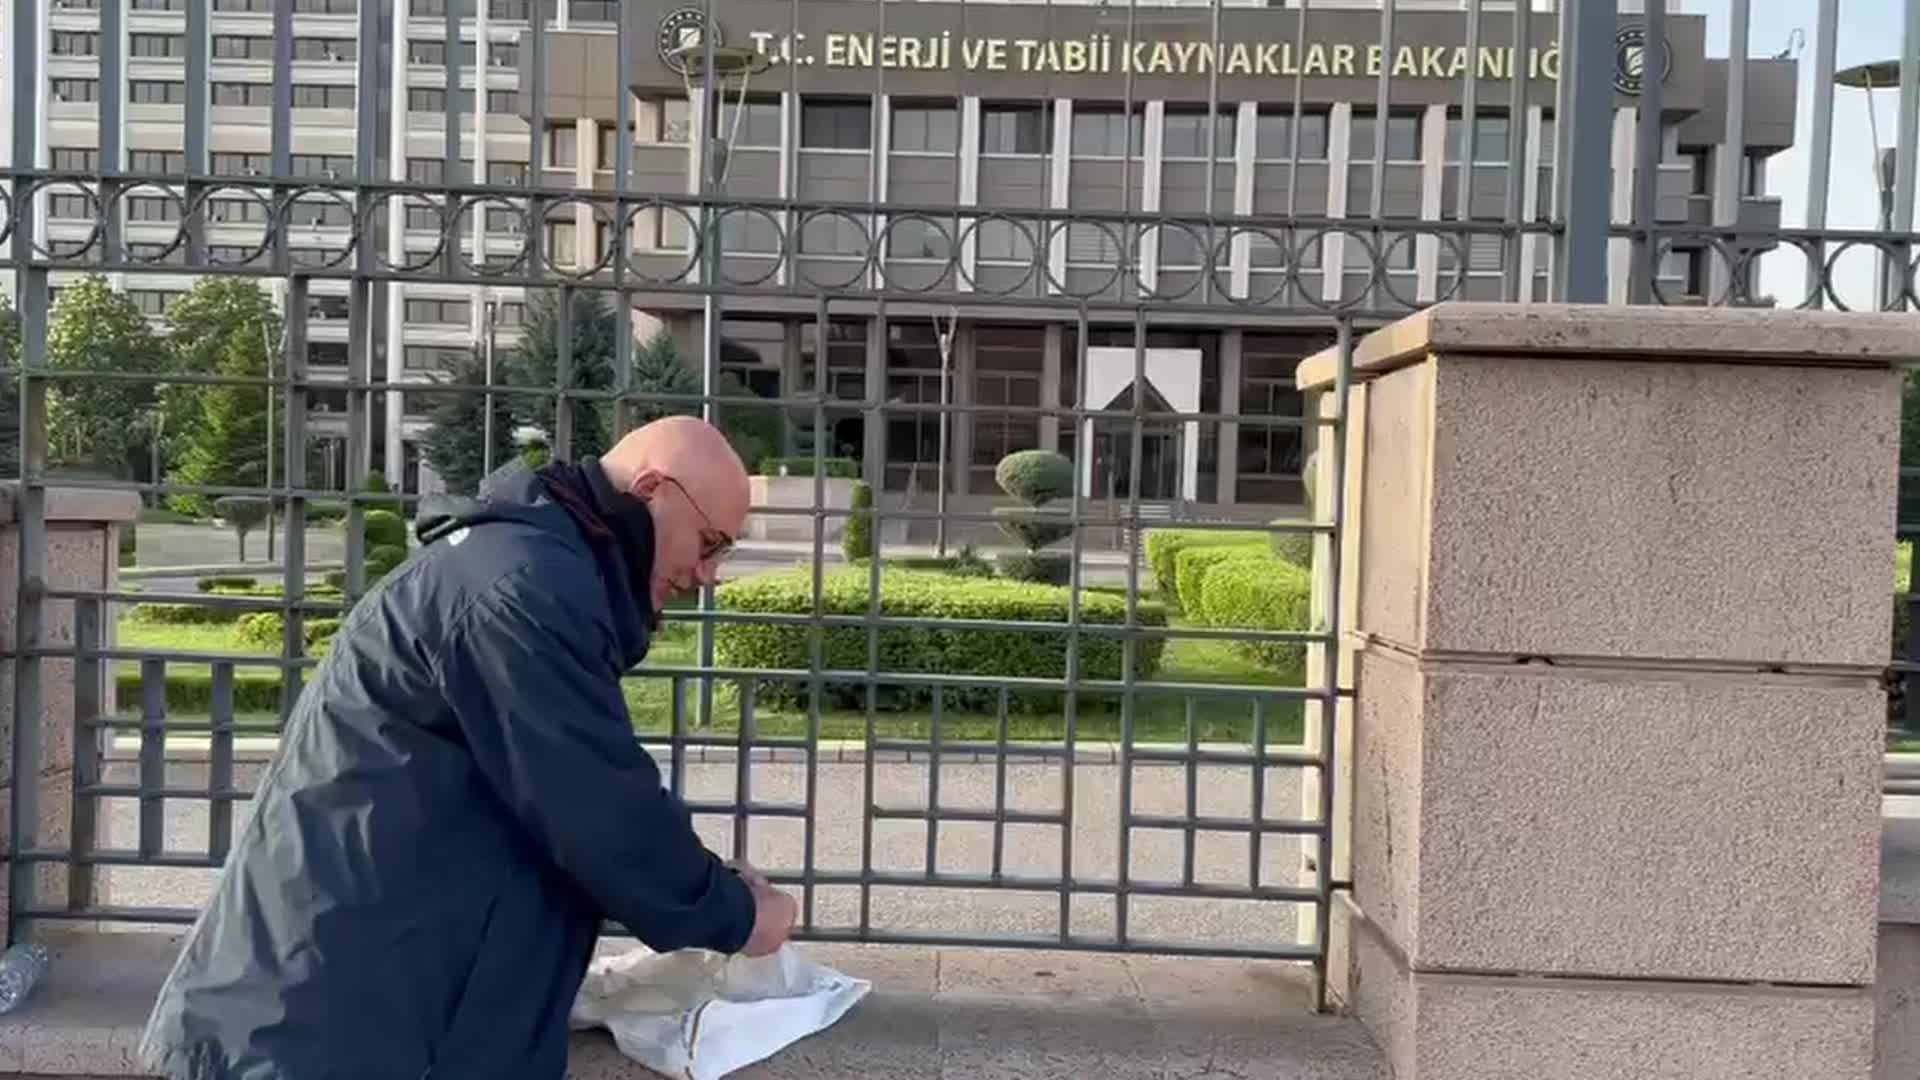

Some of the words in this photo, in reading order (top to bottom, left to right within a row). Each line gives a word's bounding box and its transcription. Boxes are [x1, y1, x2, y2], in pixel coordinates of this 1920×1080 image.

[826, 30, 950, 69] ENERJİ
[962, 37, 1007, 70] VE
[1014, 34, 1111, 72] TABİİ
[1121, 41, 1355, 75] KAYNAKLAR
[1367, 40, 1561, 79] BAKANLIĞ
